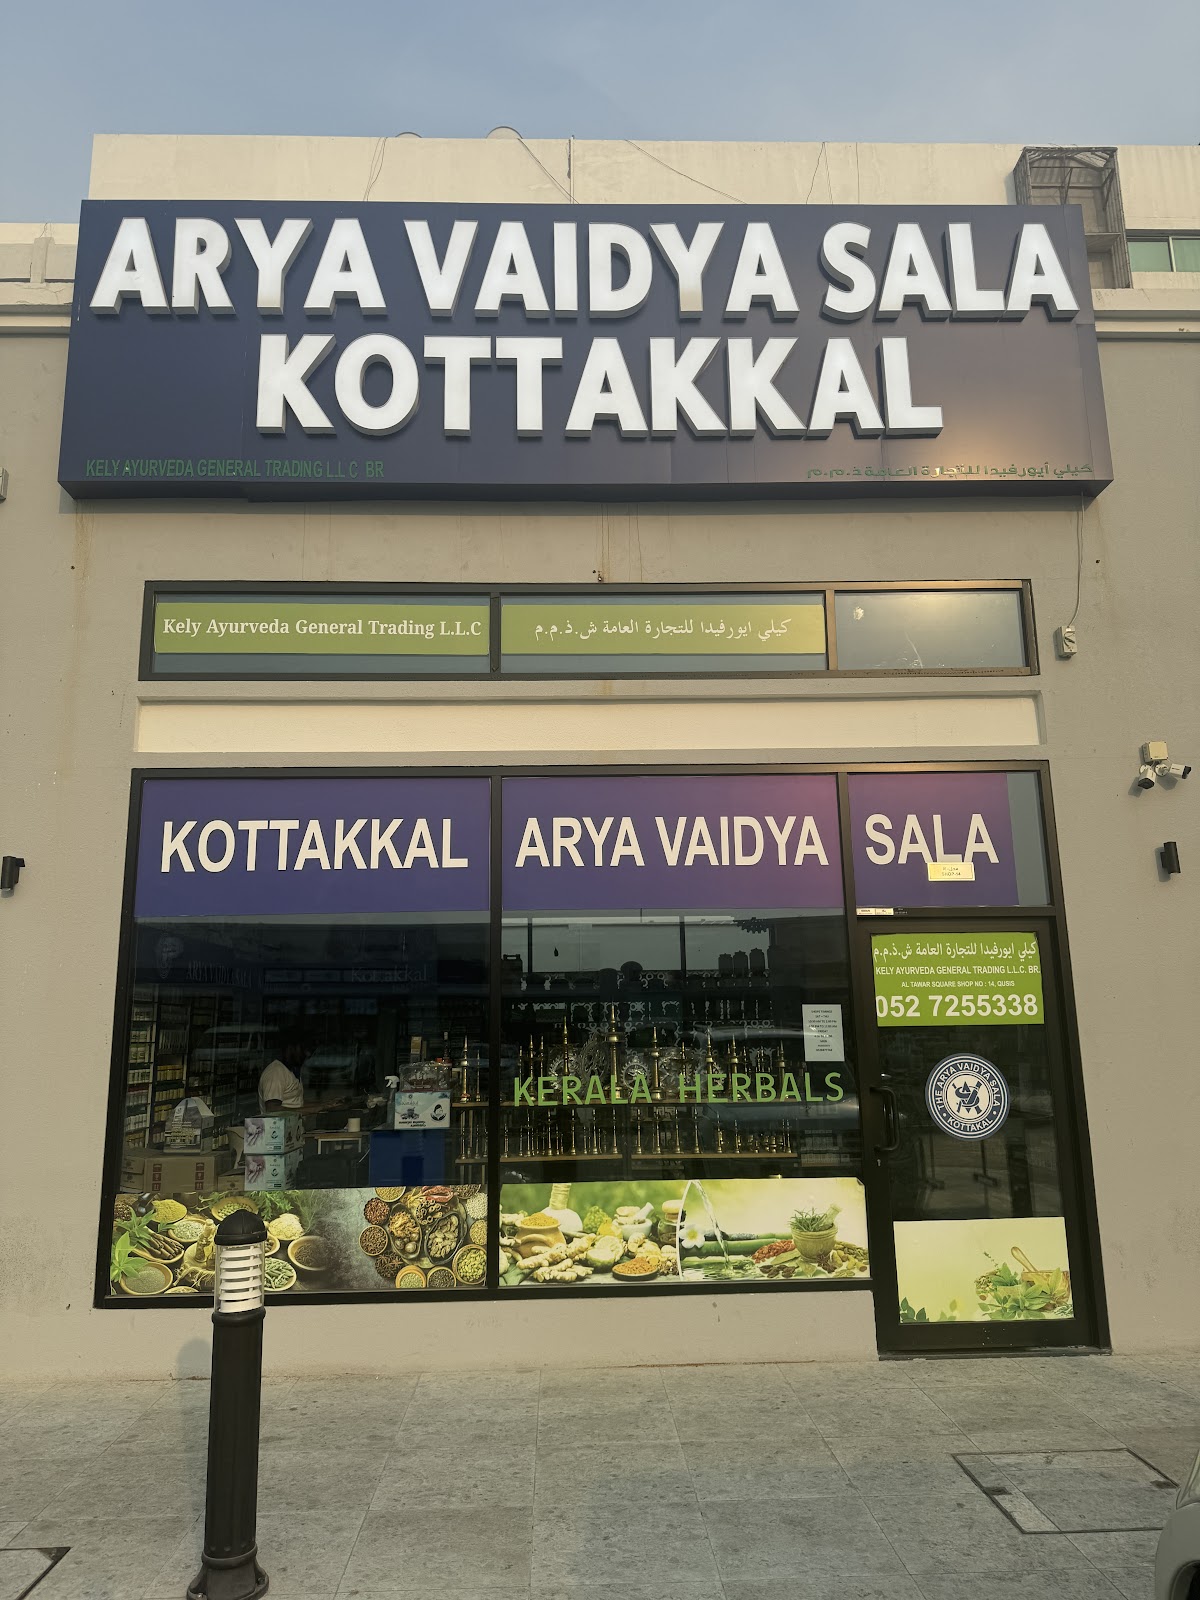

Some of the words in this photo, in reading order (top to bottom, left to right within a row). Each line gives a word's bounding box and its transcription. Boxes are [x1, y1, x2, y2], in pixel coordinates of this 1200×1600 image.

[90, 217, 387, 315] ARYA
[403, 220, 800, 319] VAIDYA
[820, 222, 1080, 321] SALA
[256, 332, 943, 438] KOTTAKKAL
[86, 459, 120, 477] KELY
[122, 459, 194, 477] AYURVEDA
[198, 459, 261, 477] GENERAL
[265, 460, 322, 477] TRADING
[365, 461, 385, 478] BR
[864, 465, 918, 477] العامة
[163, 618, 202, 637] Kely
[206, 618, 290, 637] Ayurveda
[295, 619, 363, 635] General
[368, 619, 435, 638] Trading
[439, 620, 482, 636] L.L.C
[602, 620, 639, 634] العامة
[645, 618, 694, 641] للتجارة
[700, 620, 752, 641] ايورفيدا
[758, 618, 792, 642] كيلي
[161, 818, 469, 873] KOTTAKKAL
[515, 816, 646, 868] ARYA
[654, 815, 830, 867] VAIDYA
[865, 813, 1000, 866] SALA
[916, 942, 943, 956] العامة
[946, 942, 977, 959] للتجارة
[980, 942, 1015, 959] ايورفيدا
[1017, 939, 1038, 962] كيلي
[875, 966, 894, 975] KELY
[895, 966, 936, 975] AYURVEDA
[936, 966, 971, 975] GENERAL
[972, 965, 1006, 974] TRADING
[1006, 965, 1027, 974] L.L.C.
[876, 995, 921, 1018] 052
[928, 993, 1039, 1017] 7255338
[937, 1066, 957, 1088] ARYA
[956, 1062, 991, 1080] VAIDYA
[513, 1073, 653, 1107] KERALA
[679, 1071, 845, 1104] HERBALS
[989, 1079, 1001, 1107] SALA
[935, 1090, 945, 1110] THE
[947, 1117, 993, 1132] KOTTAKAL
